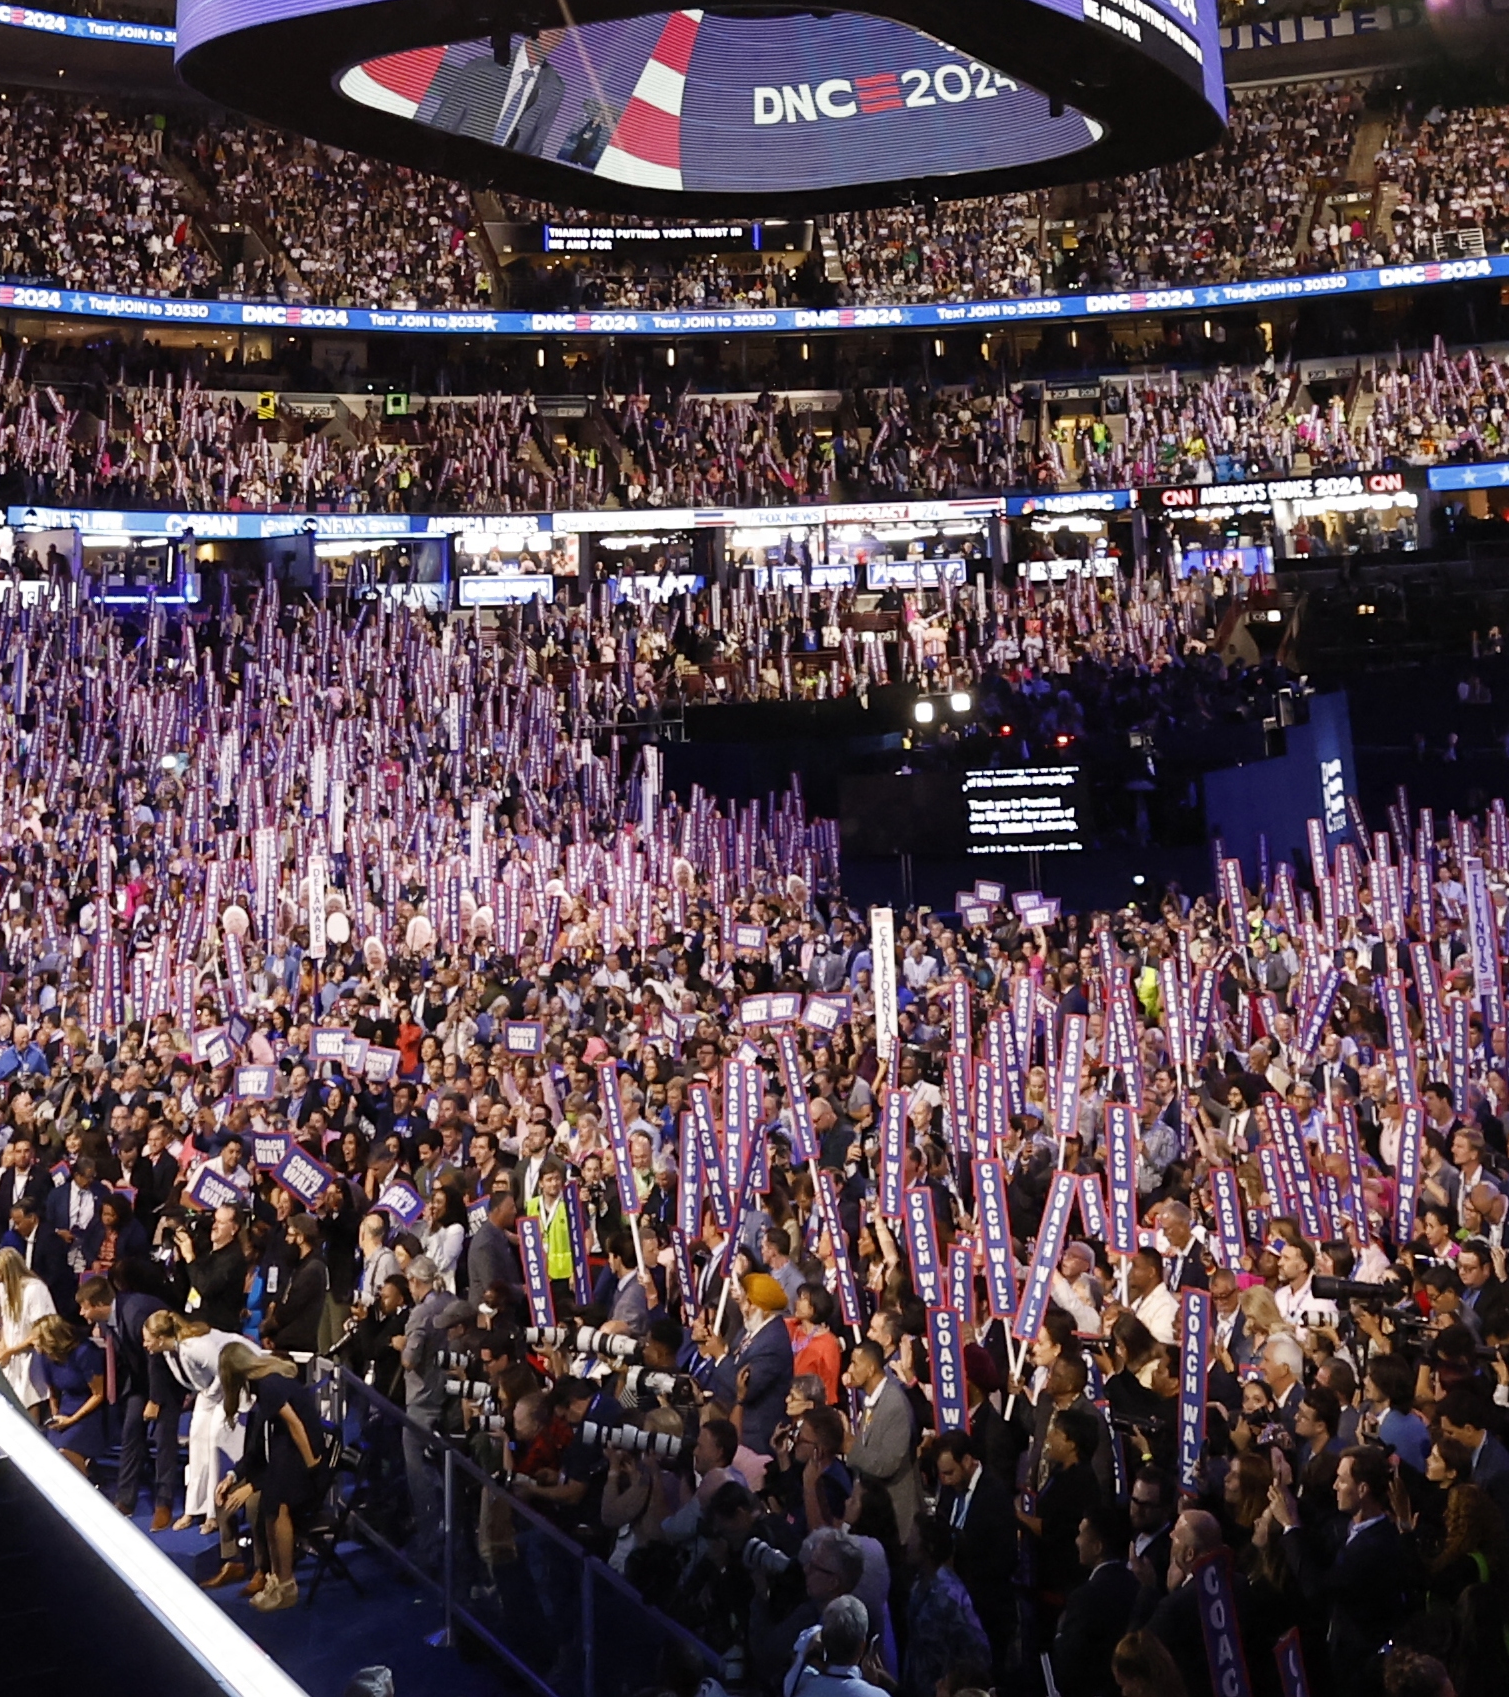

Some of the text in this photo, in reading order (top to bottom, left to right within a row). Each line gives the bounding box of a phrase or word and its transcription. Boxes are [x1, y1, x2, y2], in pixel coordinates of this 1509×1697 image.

[1100, 5, 1122, 32] AND
[1121, 16, 1141, 42] FOR
[753, 79, 857, 125] DNC
[549, 228, 590, 238] THANKS
[592, 228, 614, 238] FOR
[616, 229, 660, 239] PUTTING
[662, 228, 692, 239] YOUR
[694, 227, 728, 238] TRUST
[566, 240, 589, 250] AND
[591, 240, 612, 250] FOR
[532, 314, 638, 331] DNC 2024
[1046, 494, 1115, 512] MSNBC
[1162, 473, 1403, 506] CNN AMERICA'S CHOICE 2024 CNN
[166, 514, 238, 536] C-SPAN
[318, 515, 366, 534] NEWS
[426, 516, 486, 533] AMERICA
[759, 510, 821, 523] FOX NEWS
[827, 506, 909, 521] DEMOCRACY
[312, 868, 322, 942] DELAWARE
[1472, 874, 1488, 973] ILLINOIS
[879, 926, 891, 1035] CALIFORNIA
[1060, 1017, 1080, 1130] COACH WALZ
[1112, 1107, 1129, 1248] COACH WALZ
[980, 1163, 1010, 1310] COACH WALZ
[1024, 1176, 1070, 1333] COACH WALZ
[1182, 1293, 1201, 1486] COACH WALZ
